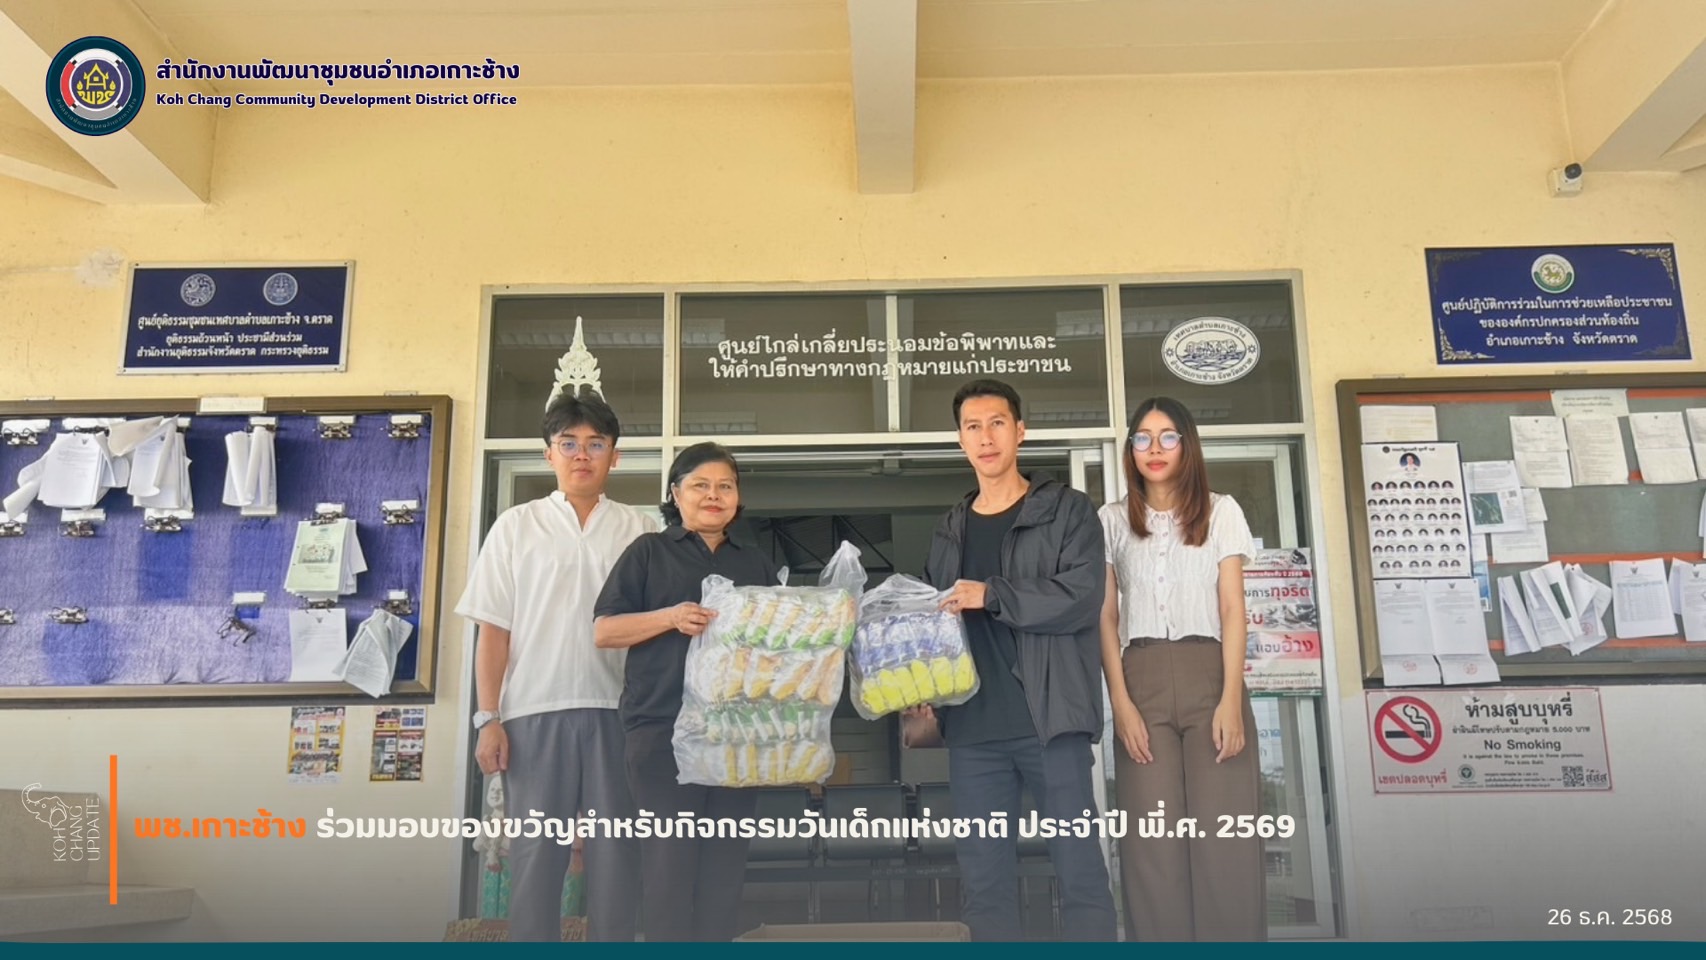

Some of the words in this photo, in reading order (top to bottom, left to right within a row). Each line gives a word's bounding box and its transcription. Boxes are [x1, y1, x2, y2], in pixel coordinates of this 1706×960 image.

[1441, 295, 1673, 315] ศูนย์ปฏิบัติการร่วมในการช่วยเหลือประชาชน
[304, 314, 334, 326] จ.ตราด
[1479, 311, 1640, 329] ขององค์กรปกครองส่วนท้องถิ่น
[718, 328, 1056, 360] ศูนย์ไกล่เกลี่ยประนอมข้อพิพาทและ
[1486, 333, 1564, 347] อำเภอเกาะช้าง
[1573, 331, 1638, 345] จังหวัดตราด
[260, 344, 329, 358] กระทรวงยุติธรรม
[1465, 691, 1573, 725] ห้ามสูบบุหรี่
[1575, 725, 1591, 733] บาท
[1484, 739, 1501, 750] No
[1507, 739, 1561, 751] Smoking
[1378, 768, 1448, 788] เขตปลอดบุหรี่
